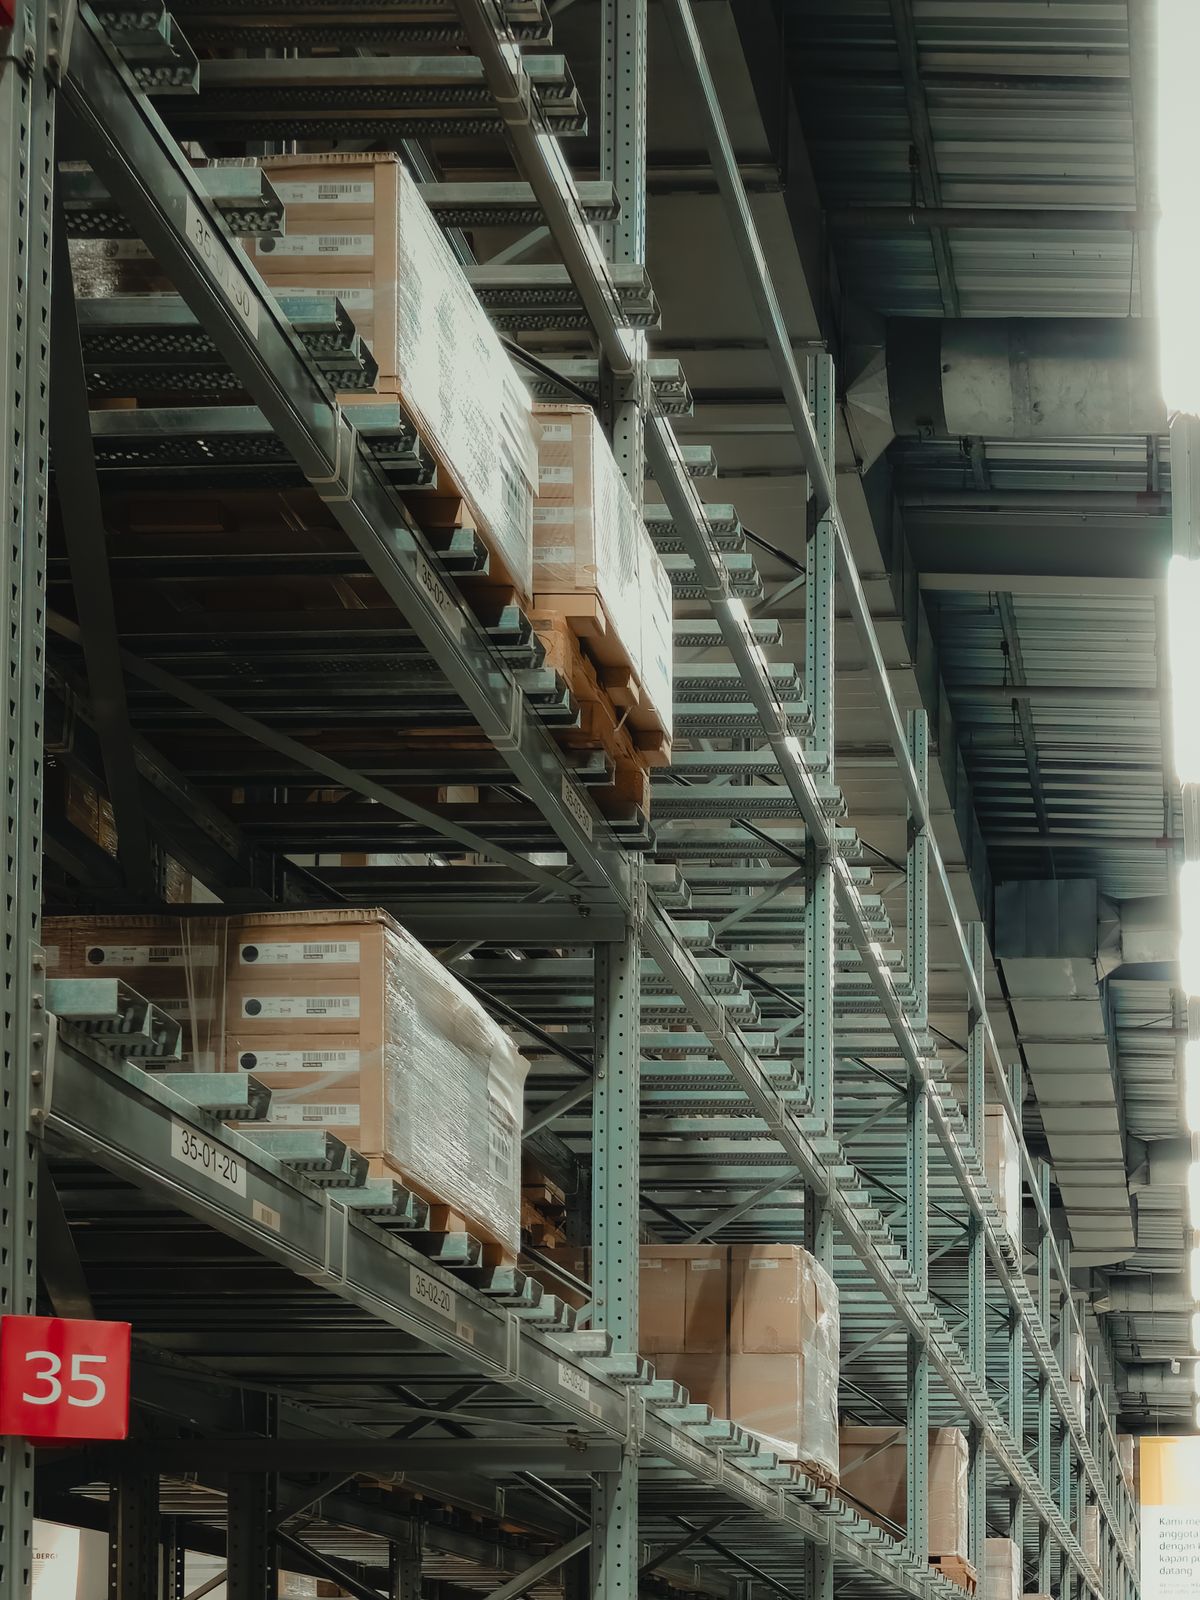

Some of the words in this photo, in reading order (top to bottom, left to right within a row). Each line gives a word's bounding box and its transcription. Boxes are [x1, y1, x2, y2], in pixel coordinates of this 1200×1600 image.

[181, 1128, 238, 1185] 35-01-20
[414, 1273, 451, 1313] 35-02-20
[21, 1350, 108, 1408] 35
[1159, 1516, 1183, 1526] Kami
[1159, 1531, 1199, 1541] anggota
[1159, 1541, 1196, 1553] dengan
[1159, 1553, 1189, 1566] kapan
[1159, 1566, 1193, 1577] datang
